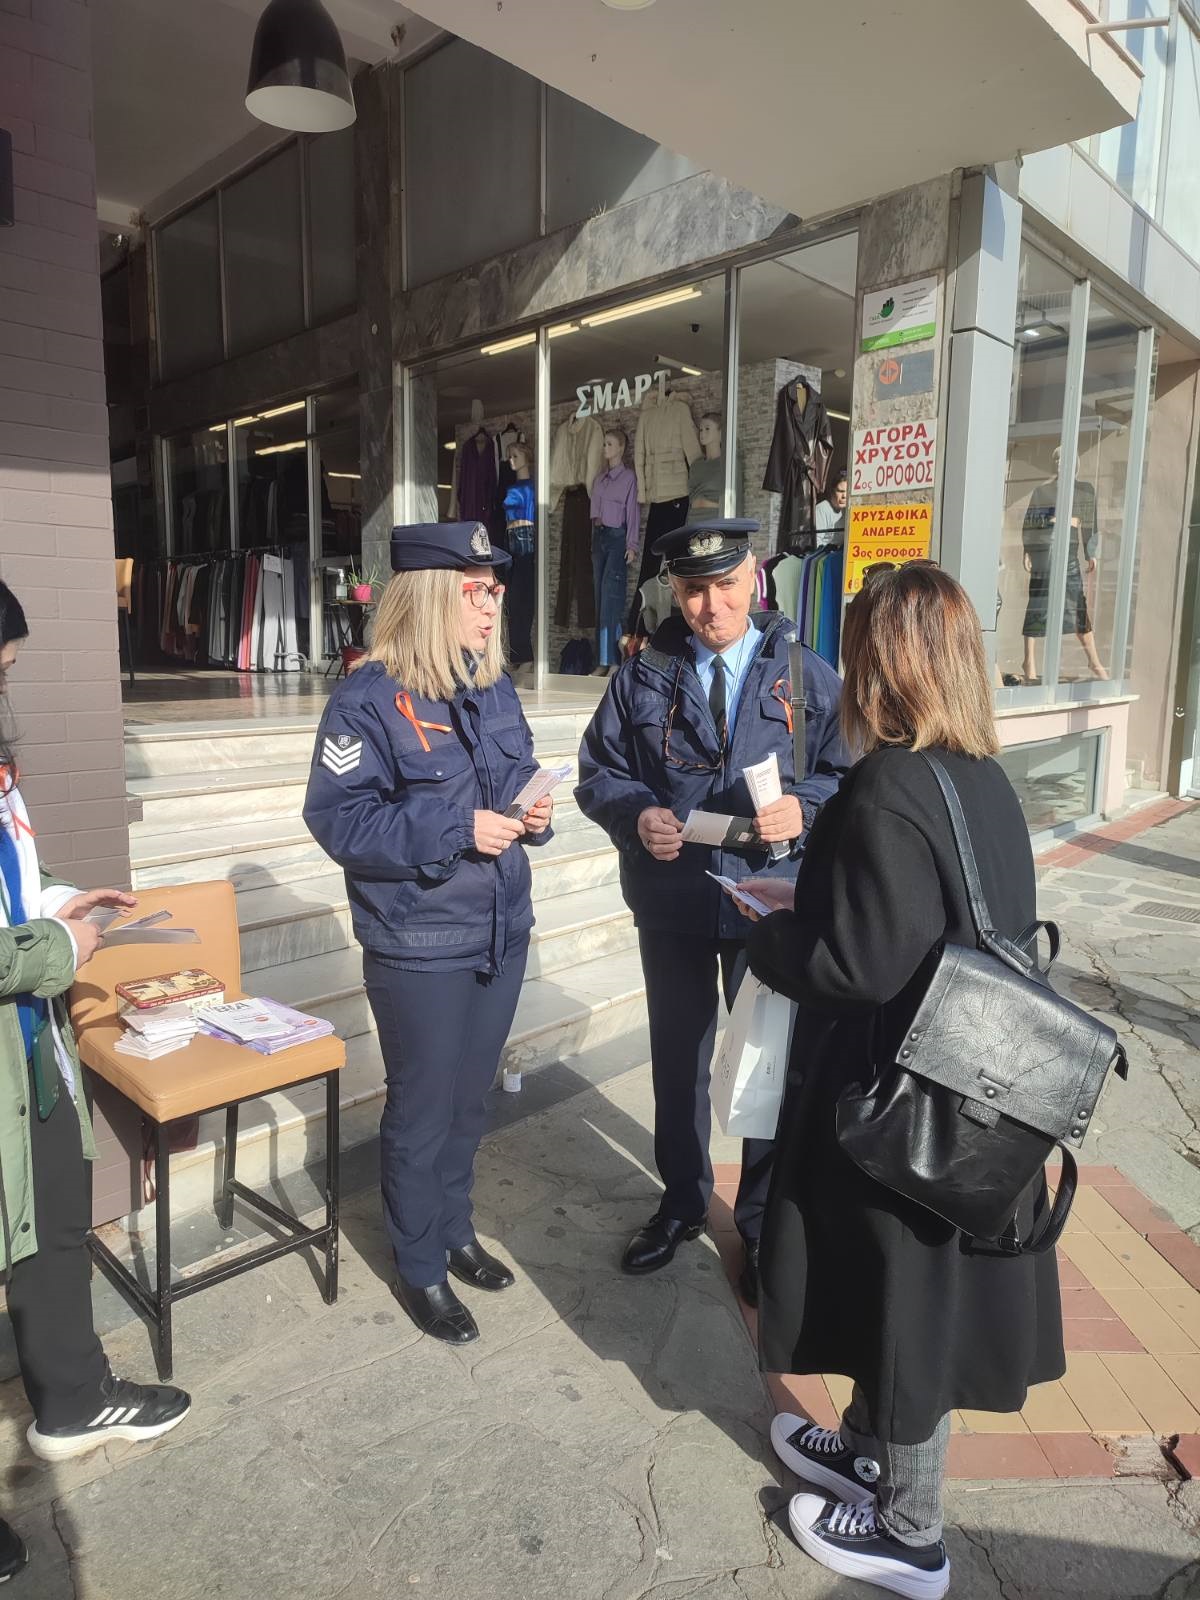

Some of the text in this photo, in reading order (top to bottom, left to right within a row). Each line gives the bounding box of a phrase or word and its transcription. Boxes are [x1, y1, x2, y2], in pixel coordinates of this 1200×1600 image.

[575, 369, 671, 418] ΣΜΑΡΤ
[862, 423, 927, 446] ΑΓΟΡΑ
[855, 439, 934, 465] ΧΡΥΣΟΥ
[853, 460, 933, 491] 2ος ΟΡΟΦΟΣ
[852, 509, 928, 522] ΧΡΥΣΑΦΙΚΑ
[862, 526, 916, 536] ΑΝΔΡΕΑΣ
[852, 545, 923, 559] 3ος ΟΡΟΦΟΣ
